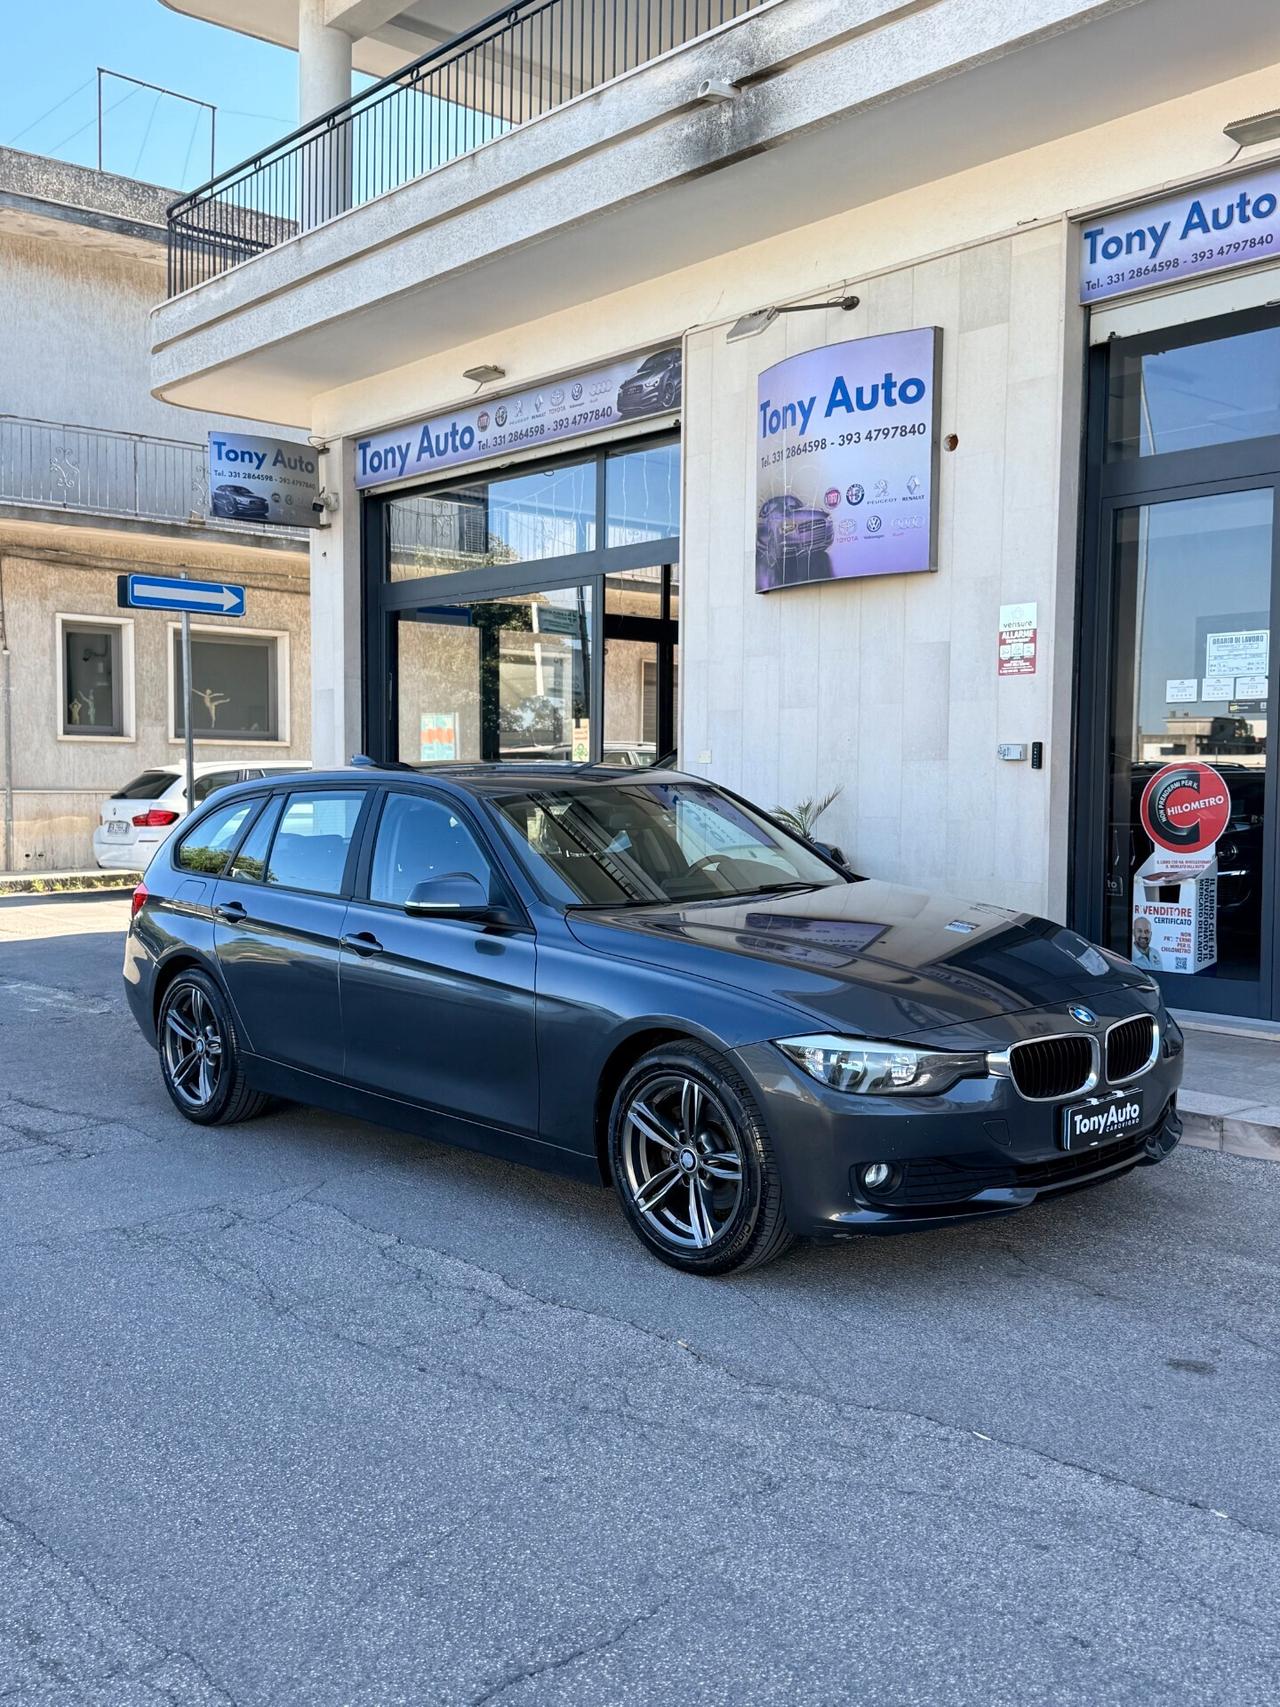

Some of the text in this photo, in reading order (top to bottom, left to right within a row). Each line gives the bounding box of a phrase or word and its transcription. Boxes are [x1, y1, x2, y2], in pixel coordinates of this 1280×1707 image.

[1084, 192, 1277, 264] Tony Auto
[1086, 280, 1103, 291] Tel.
[1107, 273, 1124, 286] 331
[1128, 258, 1180, 280] 2864598
[1191, 249, 1213, 264] 393
[1217, 233, 1273, 256] 4797840
[760, 373, 926, 438] Tony Auto
[358, 421, 475, 477] Tony Auto
[477, 440, 491, 451] Tel.
[493, 434, 506, 448] 331
[508, 424, 545, 443] 2864598
[553, 418, 570, 432] 393
[571, 406, 613, 426] 4797840
[761, 455, 771, 469] Tel.
[772, 449, 784, 464] 331
[785, 438, 827, 459] 2864598
[838, 431, 861, 447] 393
[864, 422, 927, 443] 4797840
[213, 441, 315, 474] Tony Auto
[214, 469, 227, 477] Tel.
[228, 471, 241, 479] 331
[242, 472, 273, 482] 2864598
[836, 535, 859, 543] TOYOTA
[1154, 916, 1192, 926] CERTIFICATO
[1074, 1103, 1139, 1135] TonyAuto
